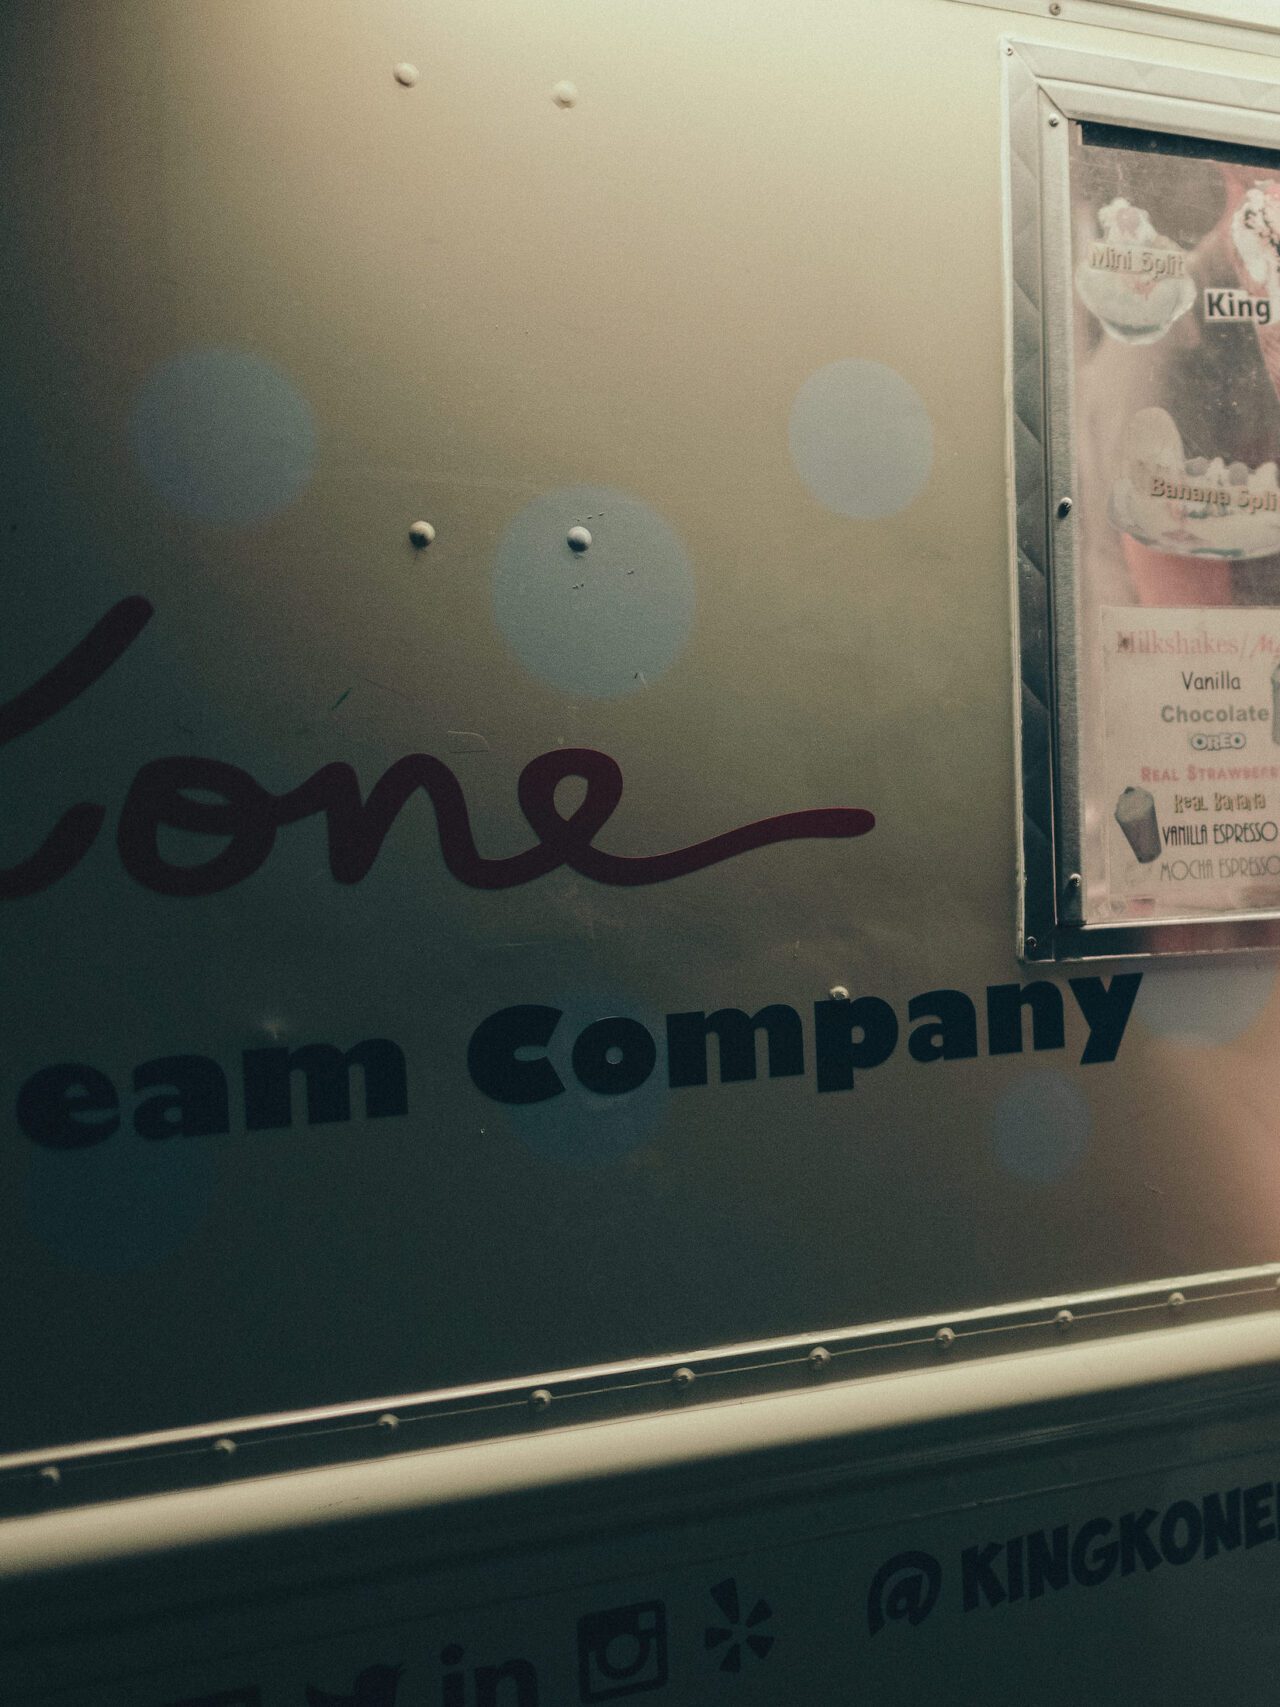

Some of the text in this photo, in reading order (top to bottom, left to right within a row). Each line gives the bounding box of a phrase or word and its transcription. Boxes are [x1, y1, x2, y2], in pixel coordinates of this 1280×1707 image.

[1090, 246, 1185, 278] Mini Split
[1207, 292, 1271, 323] King
[1151, 477, 1231, 507] Banana
[1181, 671, 1241, 691] Vanilla
[1161, 704, 1269, 723] Chocolate
[1190, 732, 1247, 752] OREO
[1162, 820, 1278, 847] VANILLA ESPRESSO
[1160, 858, 1213, 882] MOCHA
[467, 972, 1144, 1104] Company
